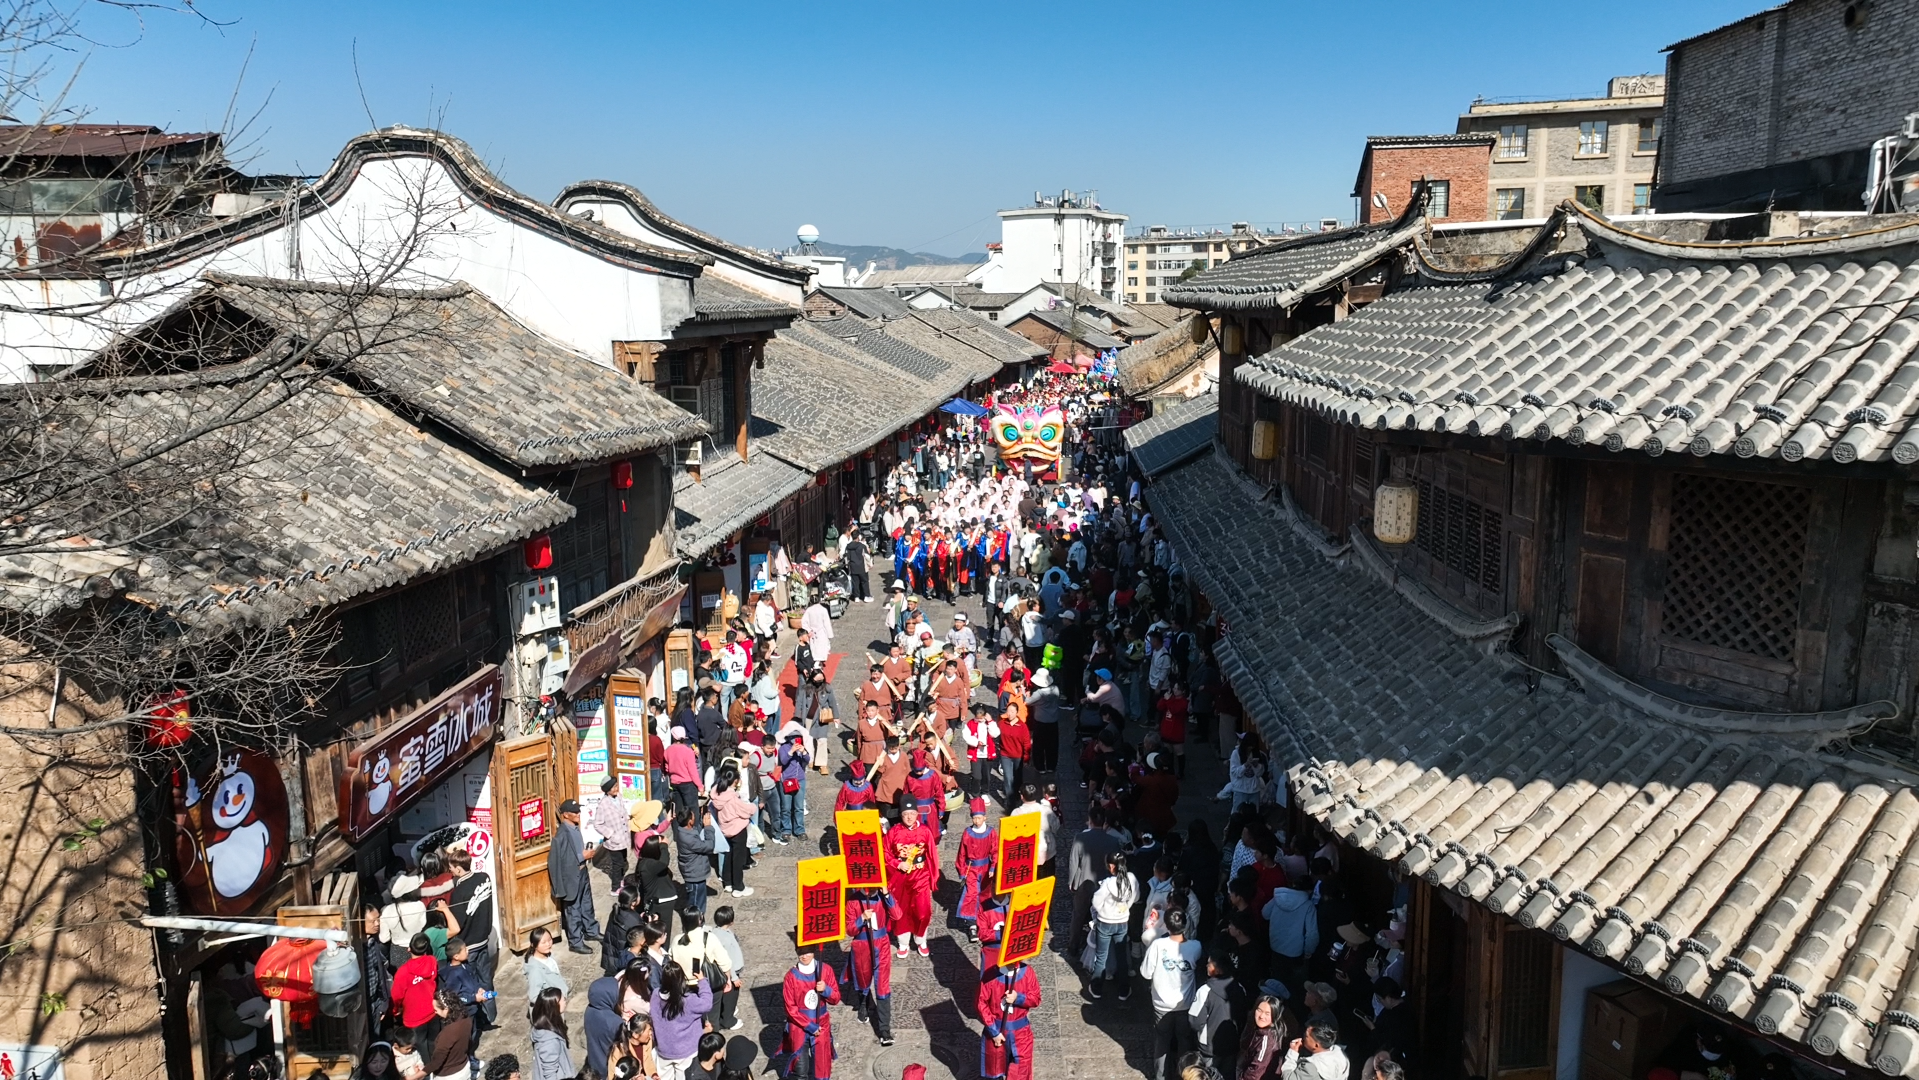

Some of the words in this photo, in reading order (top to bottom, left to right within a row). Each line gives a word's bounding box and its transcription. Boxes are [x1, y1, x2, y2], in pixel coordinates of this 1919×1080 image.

[396, 684, 493, 796] 蜜雪冰城
[578, 763, 603, 773] 手机配件
